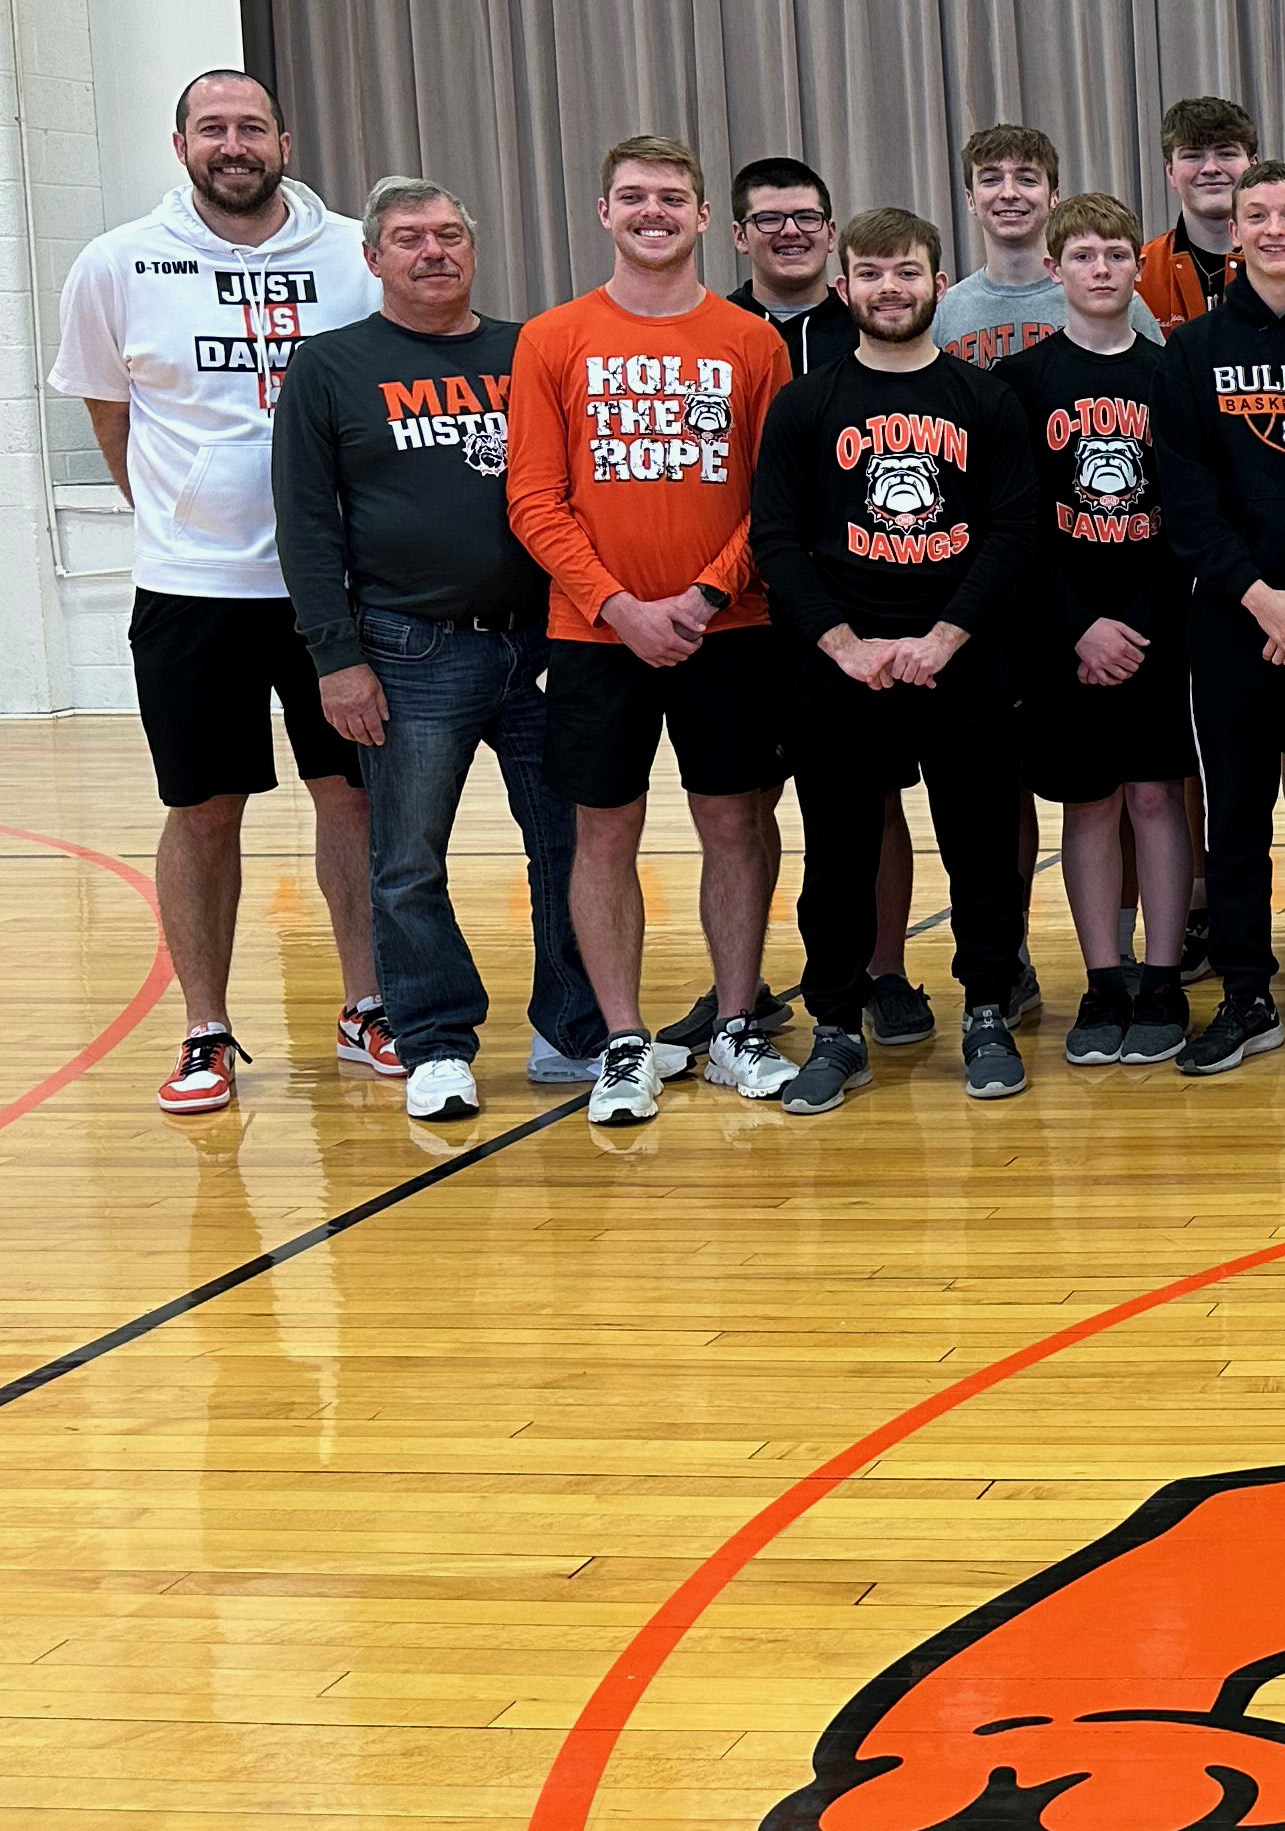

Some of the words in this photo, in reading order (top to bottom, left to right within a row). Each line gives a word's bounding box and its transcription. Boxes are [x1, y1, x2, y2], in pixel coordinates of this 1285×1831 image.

[135, 260, 200, 275] O-TOWN
[221, 273, 312, 303] JUST
[248, 306, 296, 337] US
[586, 355, 733, 396] HOLD
[586, 399, 683, 436] THE
[1046, 397, 1153, 451] O-TOW
[590, 438, 730, 483] ROPE
[836, 412, 969, 473] O-TOWN
[847, 521, 970, 565] DAWGS
